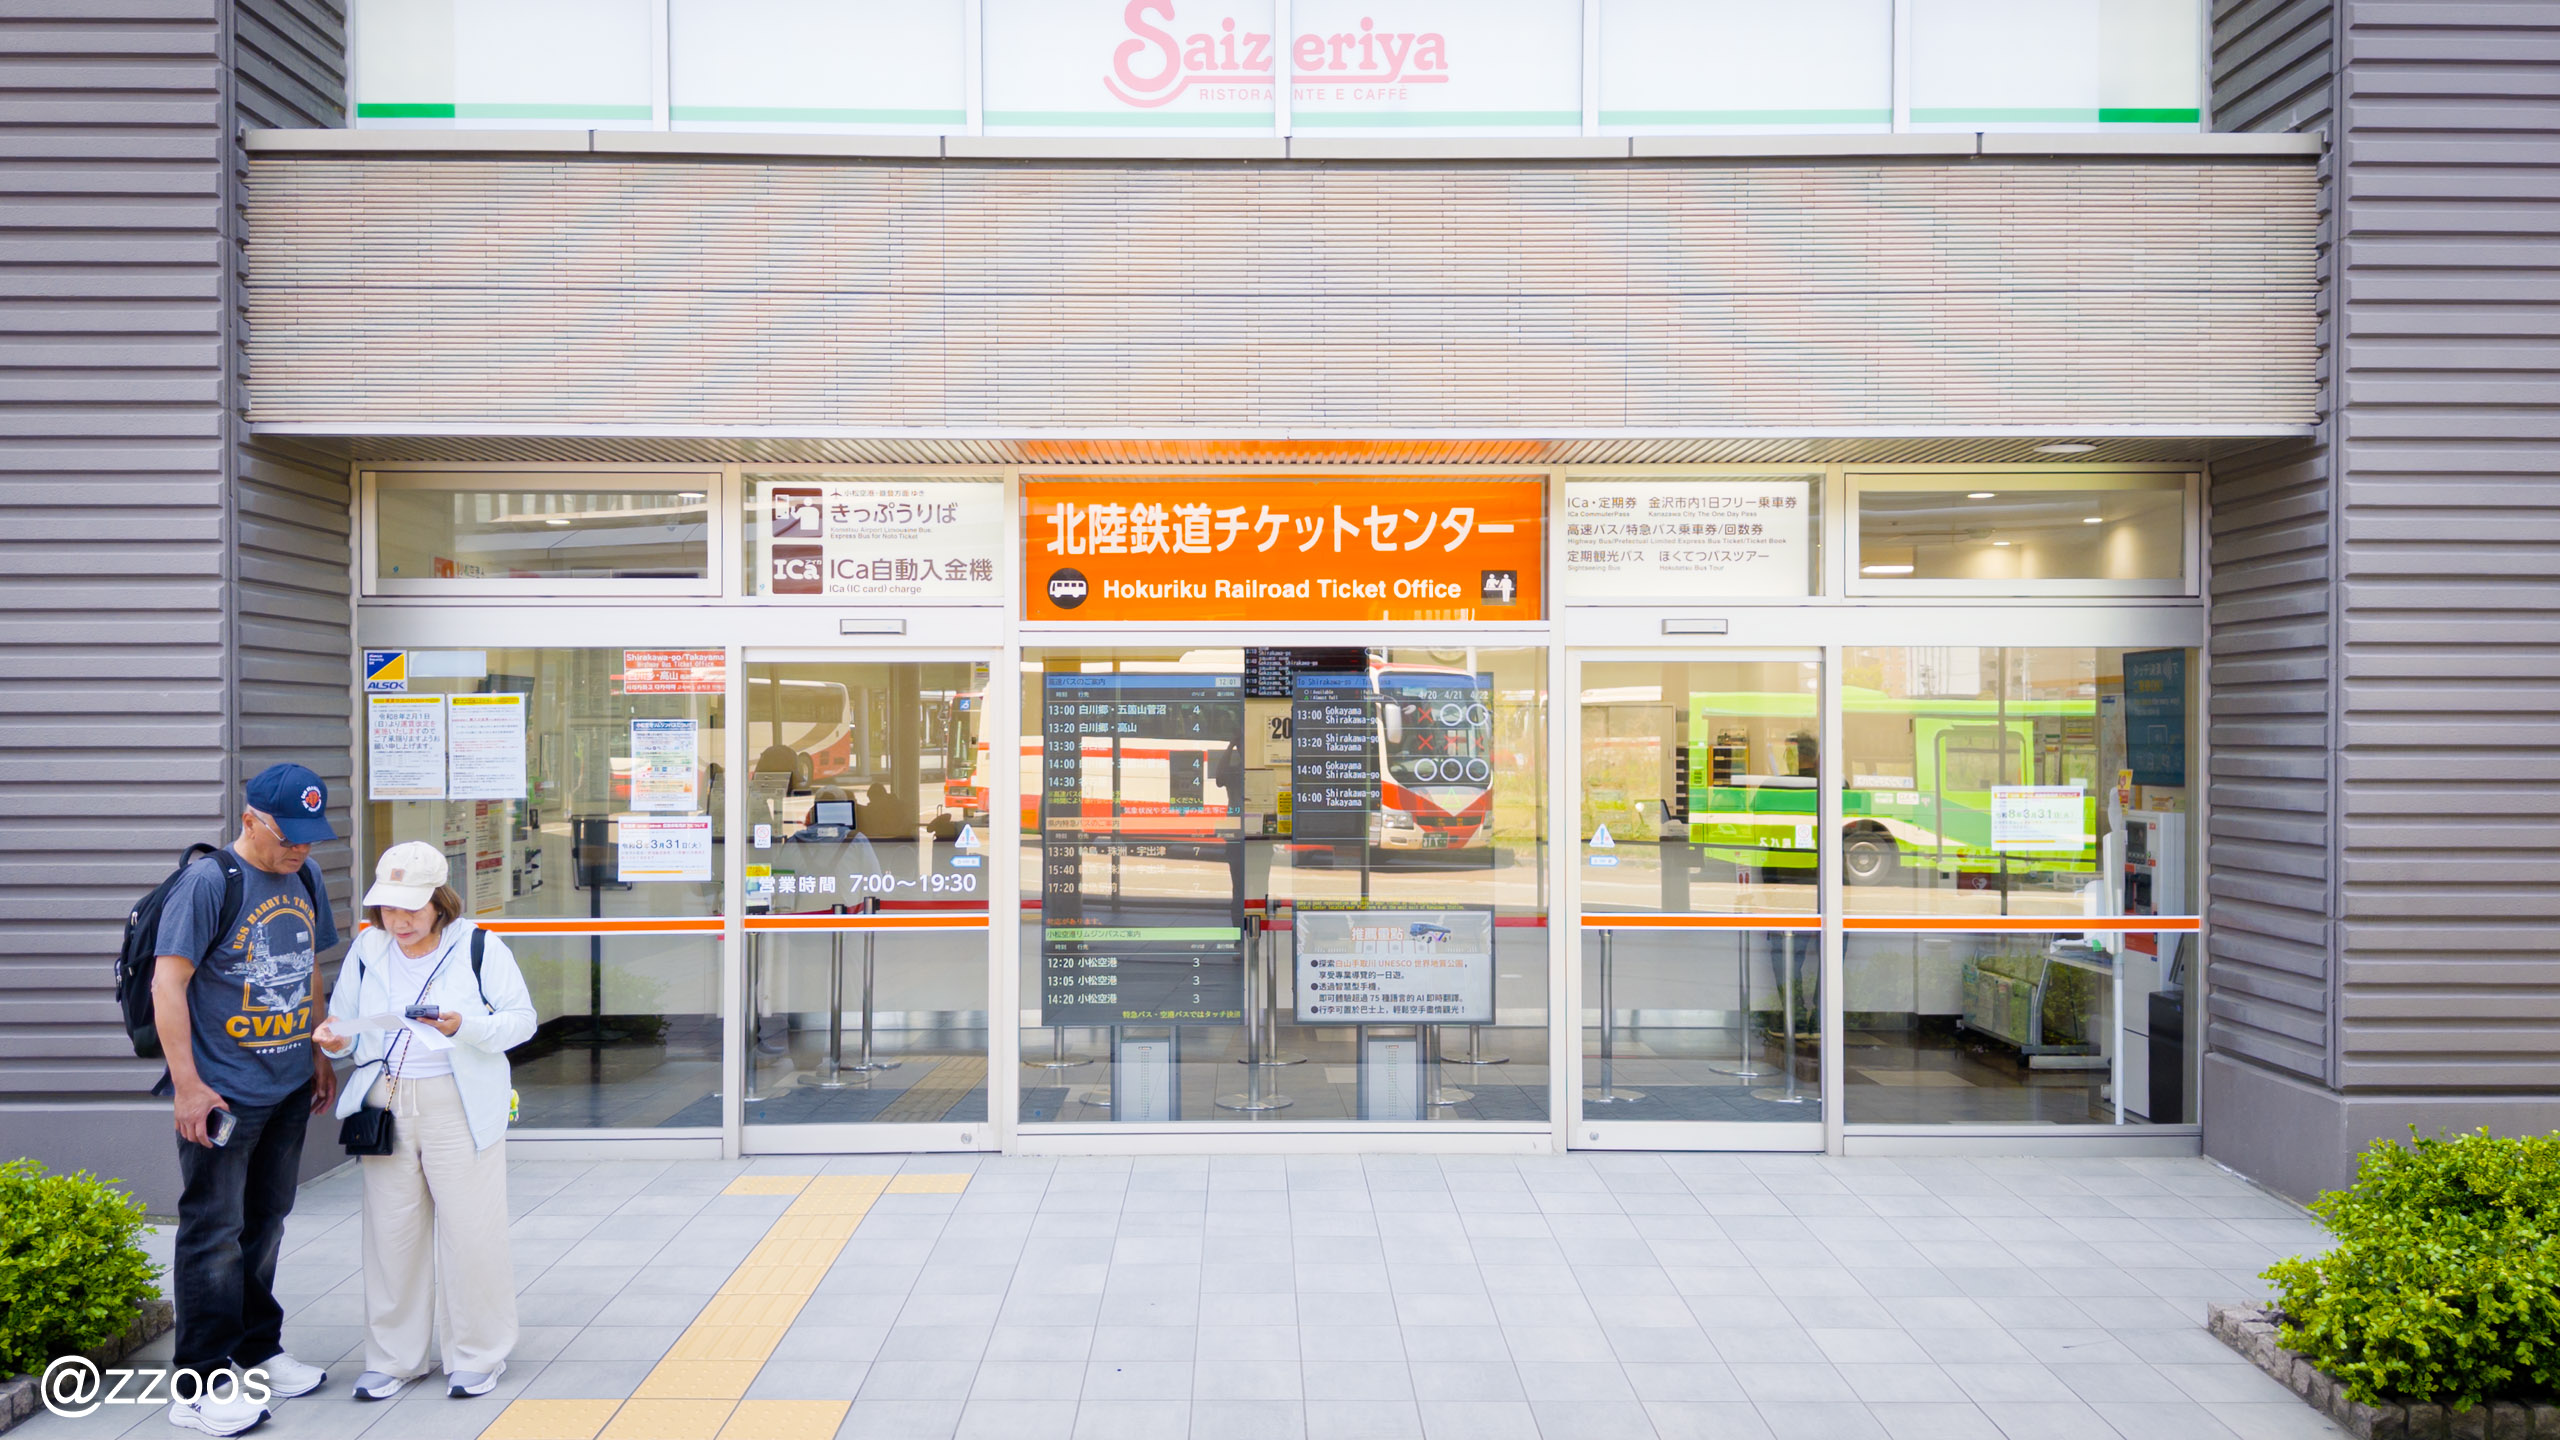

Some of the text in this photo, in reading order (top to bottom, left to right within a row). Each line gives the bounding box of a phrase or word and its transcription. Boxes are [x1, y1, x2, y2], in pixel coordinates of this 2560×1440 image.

[1108, 0, 1449, 93] Saizeriya
[1199, 88, 1326, 101] RISTORANTE
[1336, 88, 1345, 101] E
[1567, 496, 1798, 509] ICa・定期券 金沢市内1日フリー乗車券
[830, 502, 958, 524] きっぷうりば
[1046, 502, 1515, 555] 北陸鉄道チケットセンター
[1567, 523, 1764, 536] 高速バス/特急バス乗車券/回数券
[1567, 550, 1769, 563] 定期観光バス ほくてつバスツアー
[830, 558, 993, 582] ICa自動入金機
[829, 585, 845, 593] ICa
[889, 585, 922, 595] charge
[1103, 578, 1462, 599] Hokuriku Railroad Ticket Office
[367, 681, 405, 690] ALSOK
[1418, 690, 1438, 700] 4/20
[1444, 690, 1462, 700] 4/21
[1048, 705, 1075, 715] 13:00
[1192, 705, 1200, 715] 4
[1297, 706, 1362, 720] 13:00 Gokayama
[1048, 723, 1200, 733] 13:20 白川郷・高山 4
[1048, 741, 1075, 751] 13:30
[1297, 733, 1379, 748] 13:20 Shirakawa-go
[1325, 743, 1362, 752] Takayama
[1048, 759, 1075, 769] 14:00
[1192, 759, 1200, 769] 4
[1297, 761, 1362, 775] 14:00 Gokayama
[1325, 770, 1380, 780] Shirakawa-go
[1048, 777, 1075, 787] 14:30
[1192, 777, 1200, 787] 4
[1297, 788, 1380, 803] 16:00 Shirakawa-go
[1325, 798, 1362, 808] Takayama
[1048, 847, 1075, 857] 13:30
[1193, 847, 1200, 856] 7
[1048, 865, 1075, 875] 15:40
[758, 875, 836, 894] 営業時間
[1048, 883, 1075, 893] 17:20
[232, 926, 250, 950] USS
[247, 895, 280, 925] HARRY
[1047, 957, 1200, 968] 12:20 小松空港 3
[1378, 959, 1412, 968] UNESCO
[1047, 975, 1200, 986] 13:05 小松空港 3
[1047, 993, 1200, 1004] 14:20 小松空港 3
[1370, 994, 1380, 1002] 75
